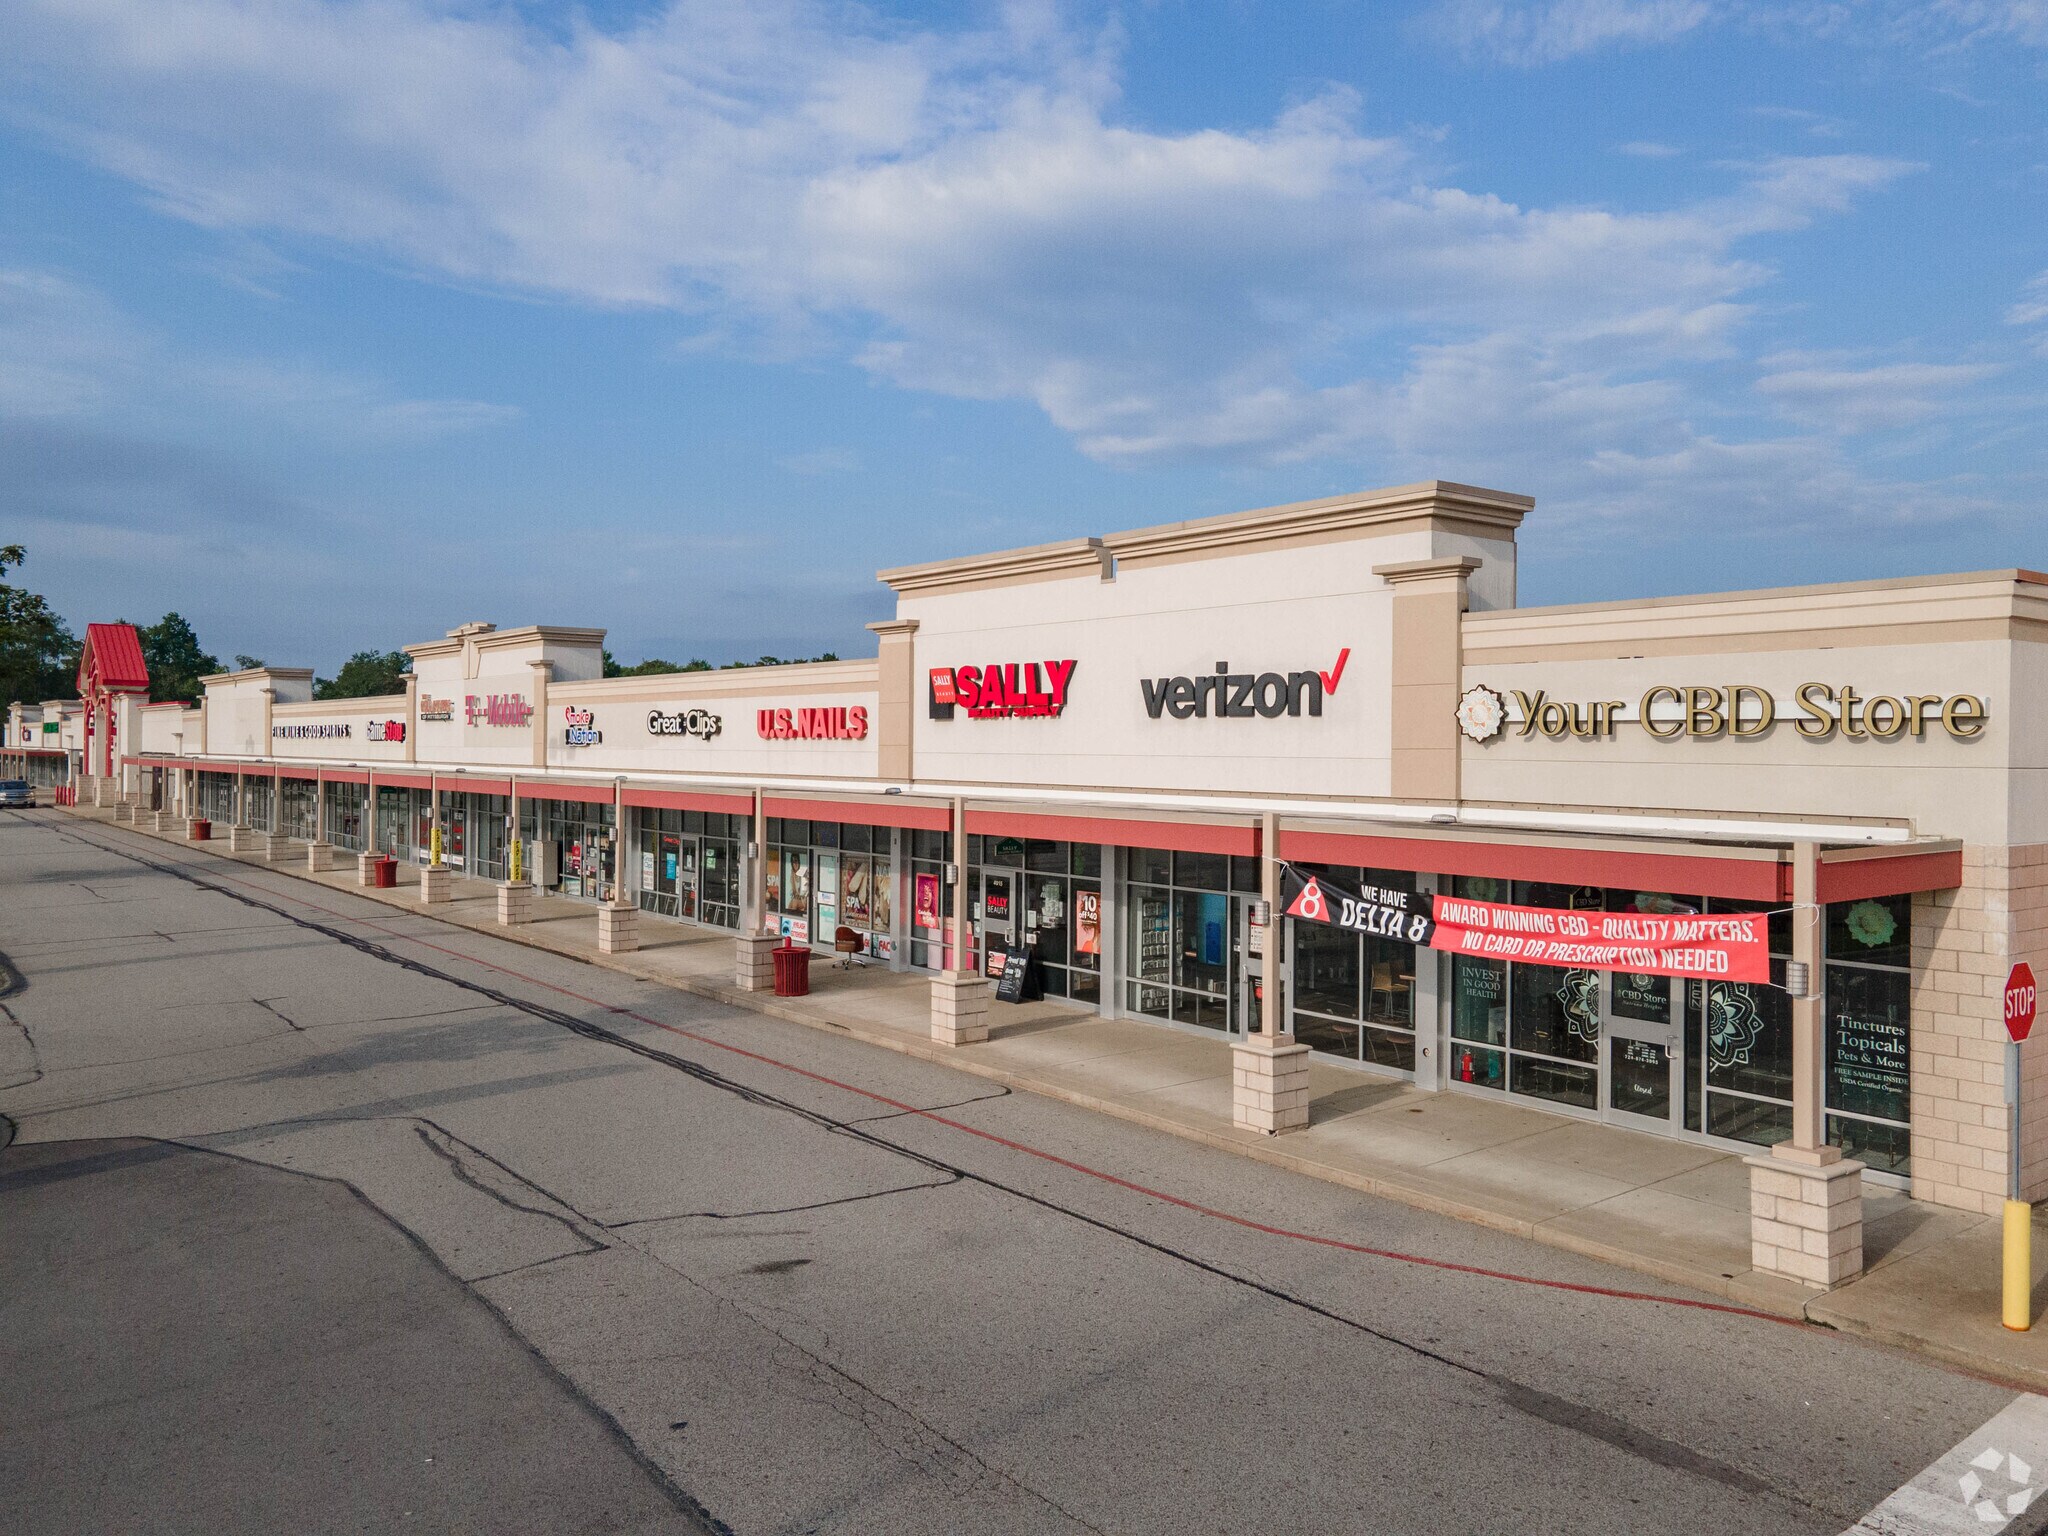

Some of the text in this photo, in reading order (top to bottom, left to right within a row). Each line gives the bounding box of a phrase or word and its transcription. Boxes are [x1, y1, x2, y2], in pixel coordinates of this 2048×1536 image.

[933, 675, 951, 686] SALLY
[957, 660, 1074, 709] SALLY
[1141, 661, 1322, 718] verizon
[565, 706, 591, 725] Smoke
[1510, 681, 1985, 738] Your CBD Store
[647, 709, 718, 741] Great Clips
[797, 706, 868, 739] NAILS
[568, 727, 600, 745] Nation
[846, 895, 860, 908] SPA
[987, 895, 1008, 907] SALLY
[1361, 884, 1408, 909] WE HAVE
[987, 905, 1008, 916] BEAUTY
[1340, 898, 1428, 942] DELTA 8
[1440, 902, 1489, 927] AWARD
[1492, 908, 1555, 933] WINNING
[1557, 915, 1589, 937] CBD
[1602, 918, 1669, 941] QUALITY
[1672, 920, 1759, 943] MATTERS.
[1461, 930, 1729, 973] NO CARD OR PRESCRIPTION NEEDED
[1462, 966, 1503, 982] INVEST
[1463, 978, 1501, 991] IN GOOD
[1466, 987, 1497, 1000] HEALTH
[1621, 989, 1641, 1000] CBD
[1643, 992, 1667, 1005] Store
[2006, 985, 2035, 1019] STOP
[1836, 1014, 1906, 1037] Tinctures
[1836, 1030, 1906, 1055] Topicals
[1837, 1049, 1906, 1069] Pets & More
[1834, 1067, 1909, 1086] FREE SAMPLE INSIDE
